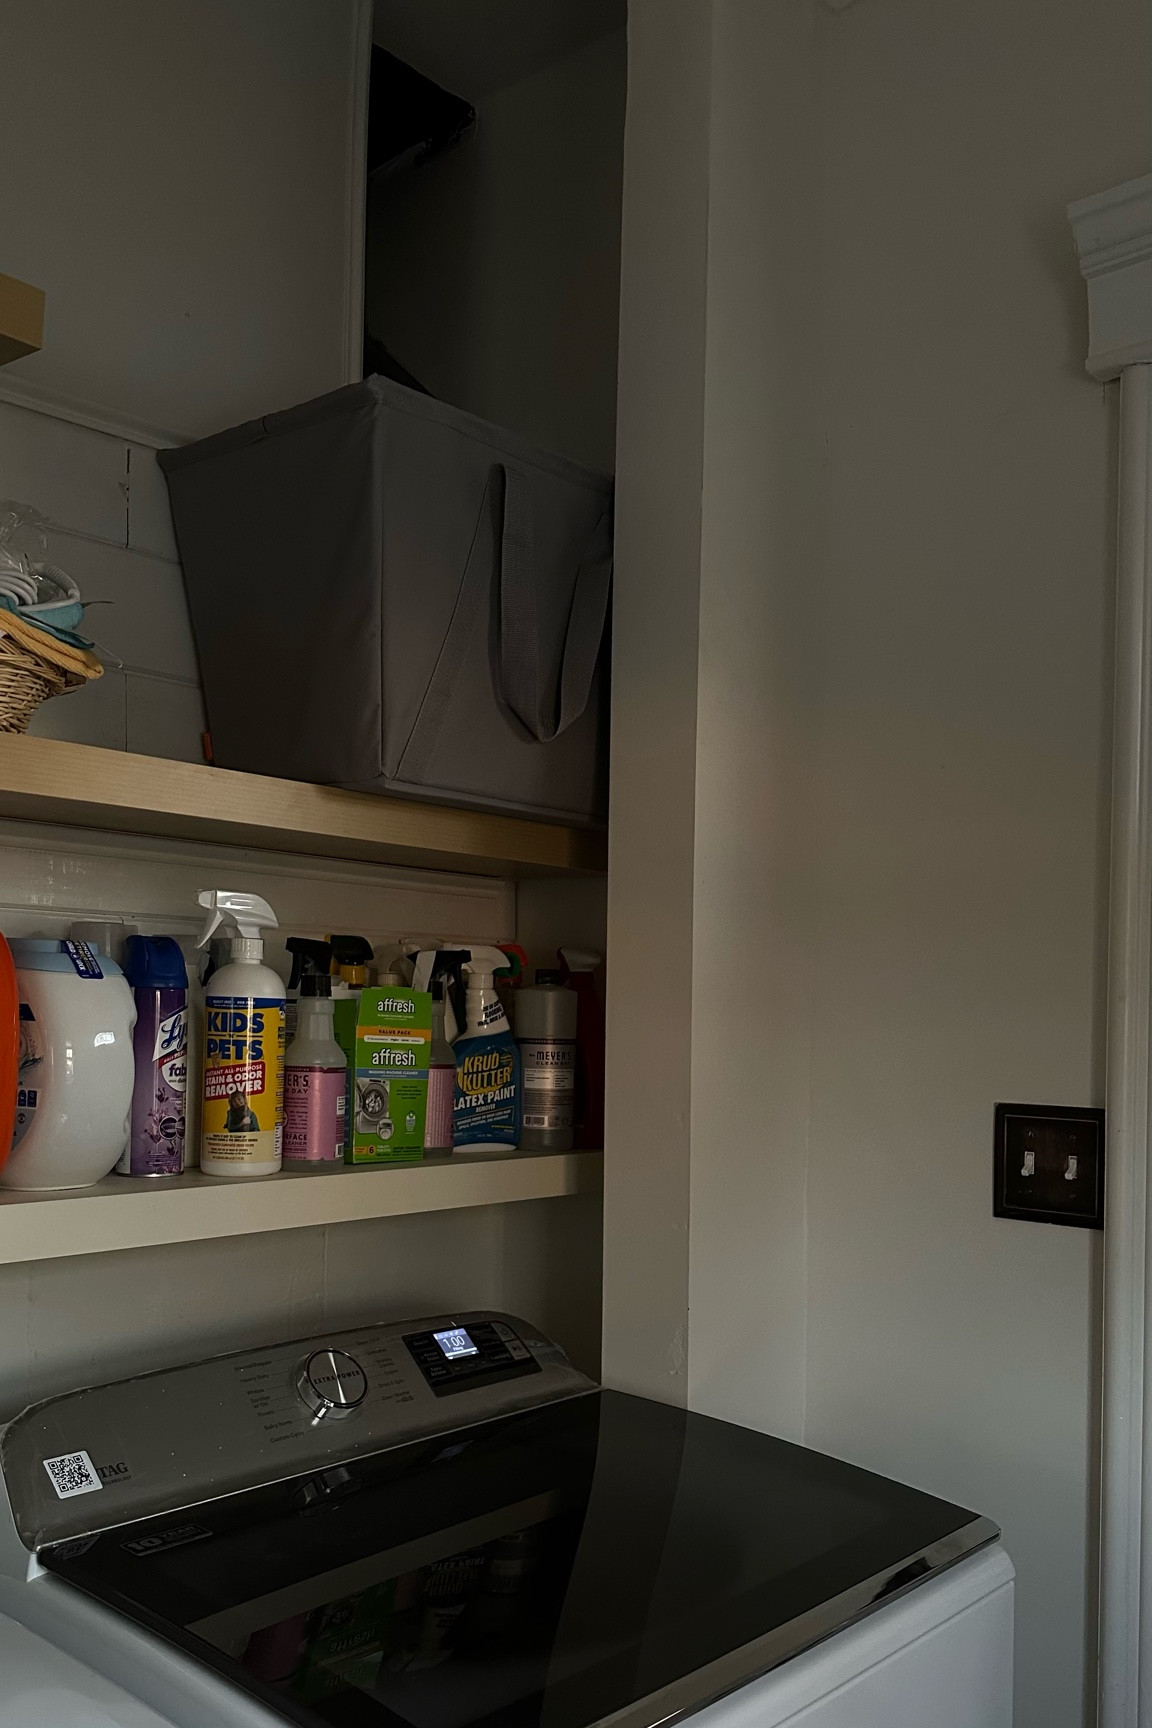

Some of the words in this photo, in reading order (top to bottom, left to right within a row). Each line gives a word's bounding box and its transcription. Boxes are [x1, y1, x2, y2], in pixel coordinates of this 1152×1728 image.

[377, 998, 415, 1013] affresh
[207, 1011, 265, 1033] KIDS
[207, 1038, 264, 1060] PETS
[372, 1048, 416, 1066] affresh
[536, 1051, 571, 1061] MEYER'S
[464, 1053, 500, 1073] KRUD
[205, 1076, 225, 1086] STAIN
[226, 1075, 233, 1083] &
[234, 1071, 262, 1081] ODOR
[463, 1067, 511, 1091] KUTTER
[205, 1080, 262, 1097] REMOVER
[453, 1093, 485, 1110] LATEX
[488, 1085, 516, 1103] PAINT
[368, 1146, 374, 1154] 6
[313, 1375, 336, 1385] EXTRA
[96, 1462, 128, 1478] TAG
